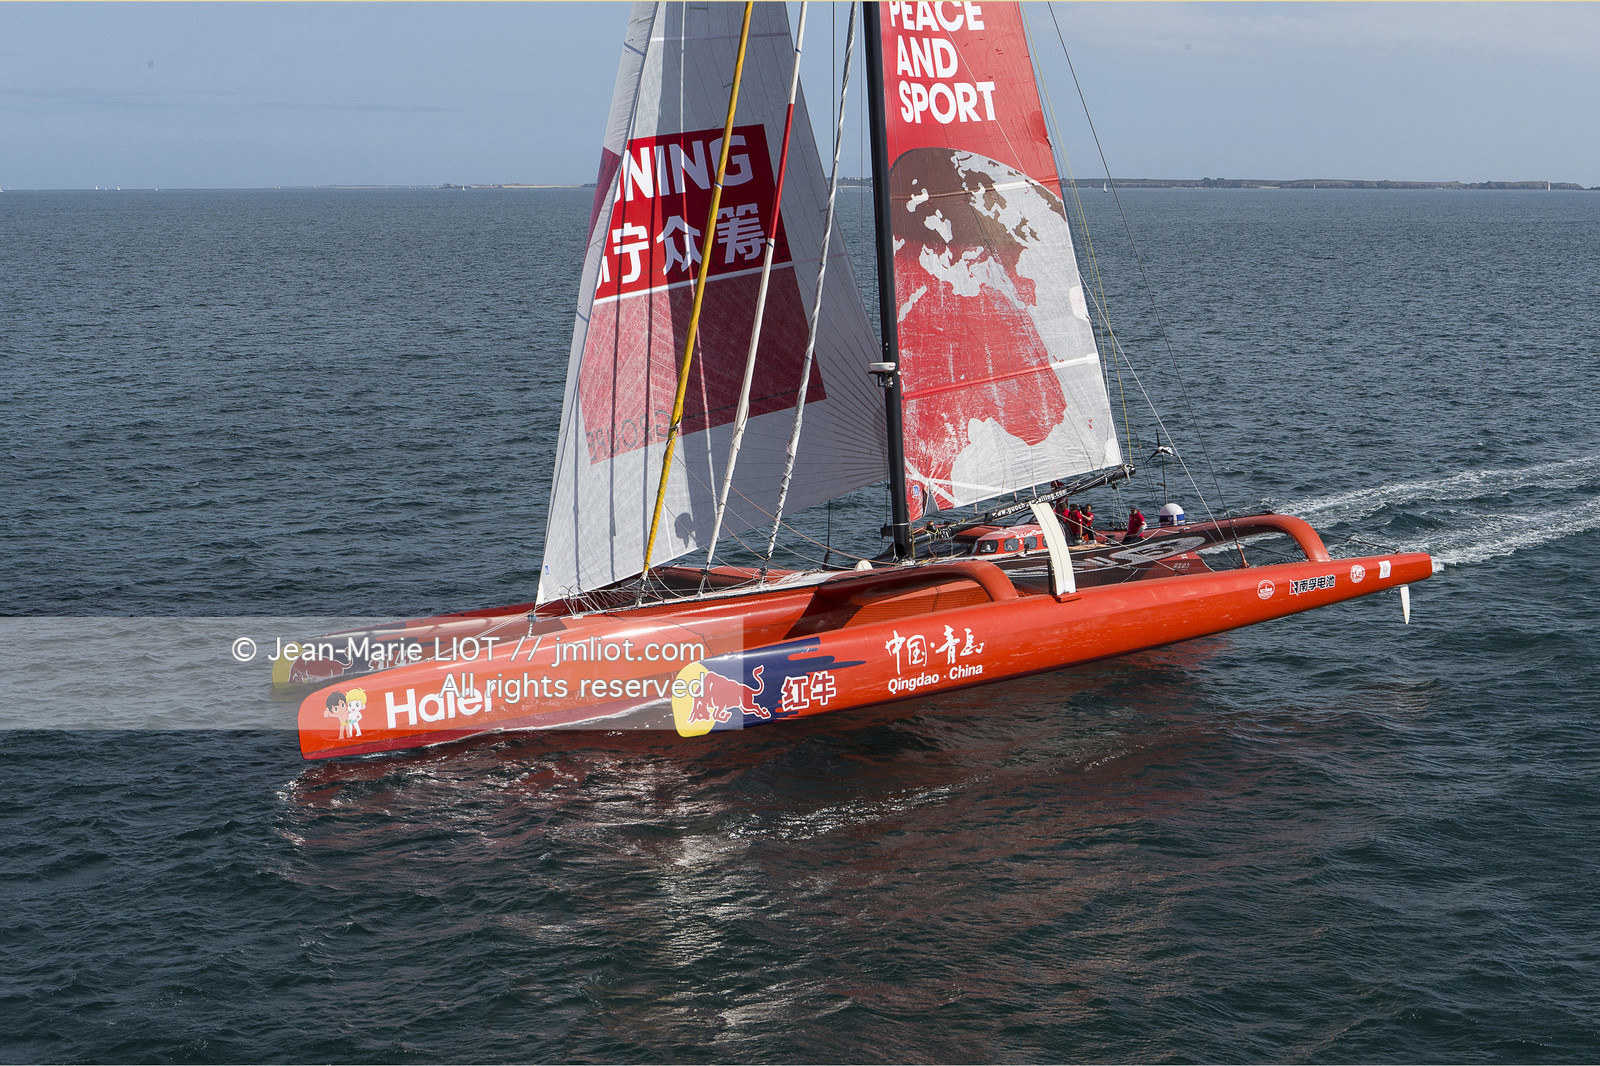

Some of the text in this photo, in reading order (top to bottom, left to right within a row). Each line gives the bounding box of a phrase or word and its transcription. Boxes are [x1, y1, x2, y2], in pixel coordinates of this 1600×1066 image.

[889, 1, 985, 31] PEACE
[897, 35, 958, 78] AND
[899, 80, 996, 124] SPORT
[596, 203, 766, 289] 宁众筹
[781, 671, 837, 711] 红牛
[887, 672, 939, 695] Qingdao
[949, 662, 983, 681] China
[385, 684, 497, 729] Haier
